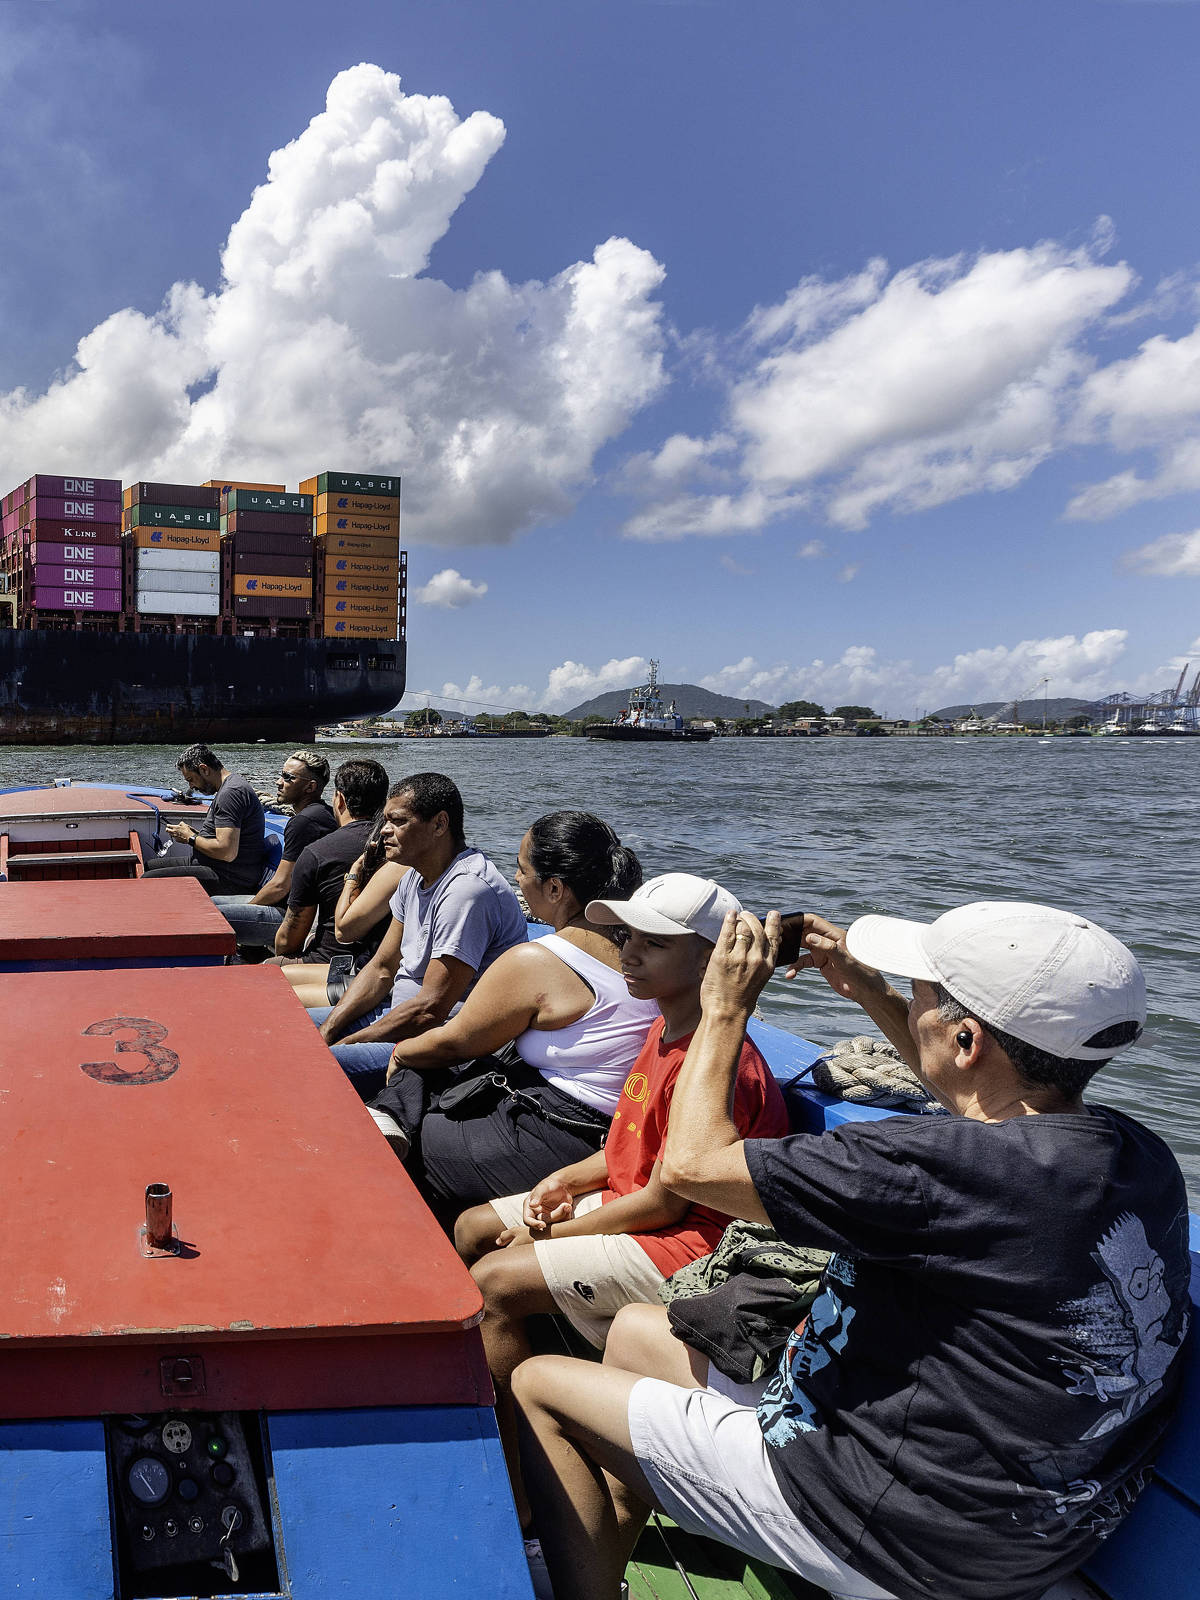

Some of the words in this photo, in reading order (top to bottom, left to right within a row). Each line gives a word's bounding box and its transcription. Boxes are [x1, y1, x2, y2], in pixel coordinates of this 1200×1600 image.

[64, 480, 95, 493] ONE
[64, 502, 95, 515] ONE
[352, 501, 391, 511] Hapag-Lloyd
[352, 521, 391, 531] Hapag-Lloyd
[75, 530, 97, 538] LINE
[167, 534, 210, 544] Hapag-Lloyd
[64, 546, 95, 560] ONE
[350, 562, 390, 572] Hapag-Lloyd
[64, 568, 95, 582] ONE
[261, 582, 302, 591] Hapag-Lloyd
[350, 583, 389, 592] Hapag-Lloyd
[64, 590, 94, 604] ONE
[350, 604, 389, 613] Hapag-Lloyd
[349, 624, 388, 633] Hapag-Lloyd
[79, 1016, 181, 1086] 3
